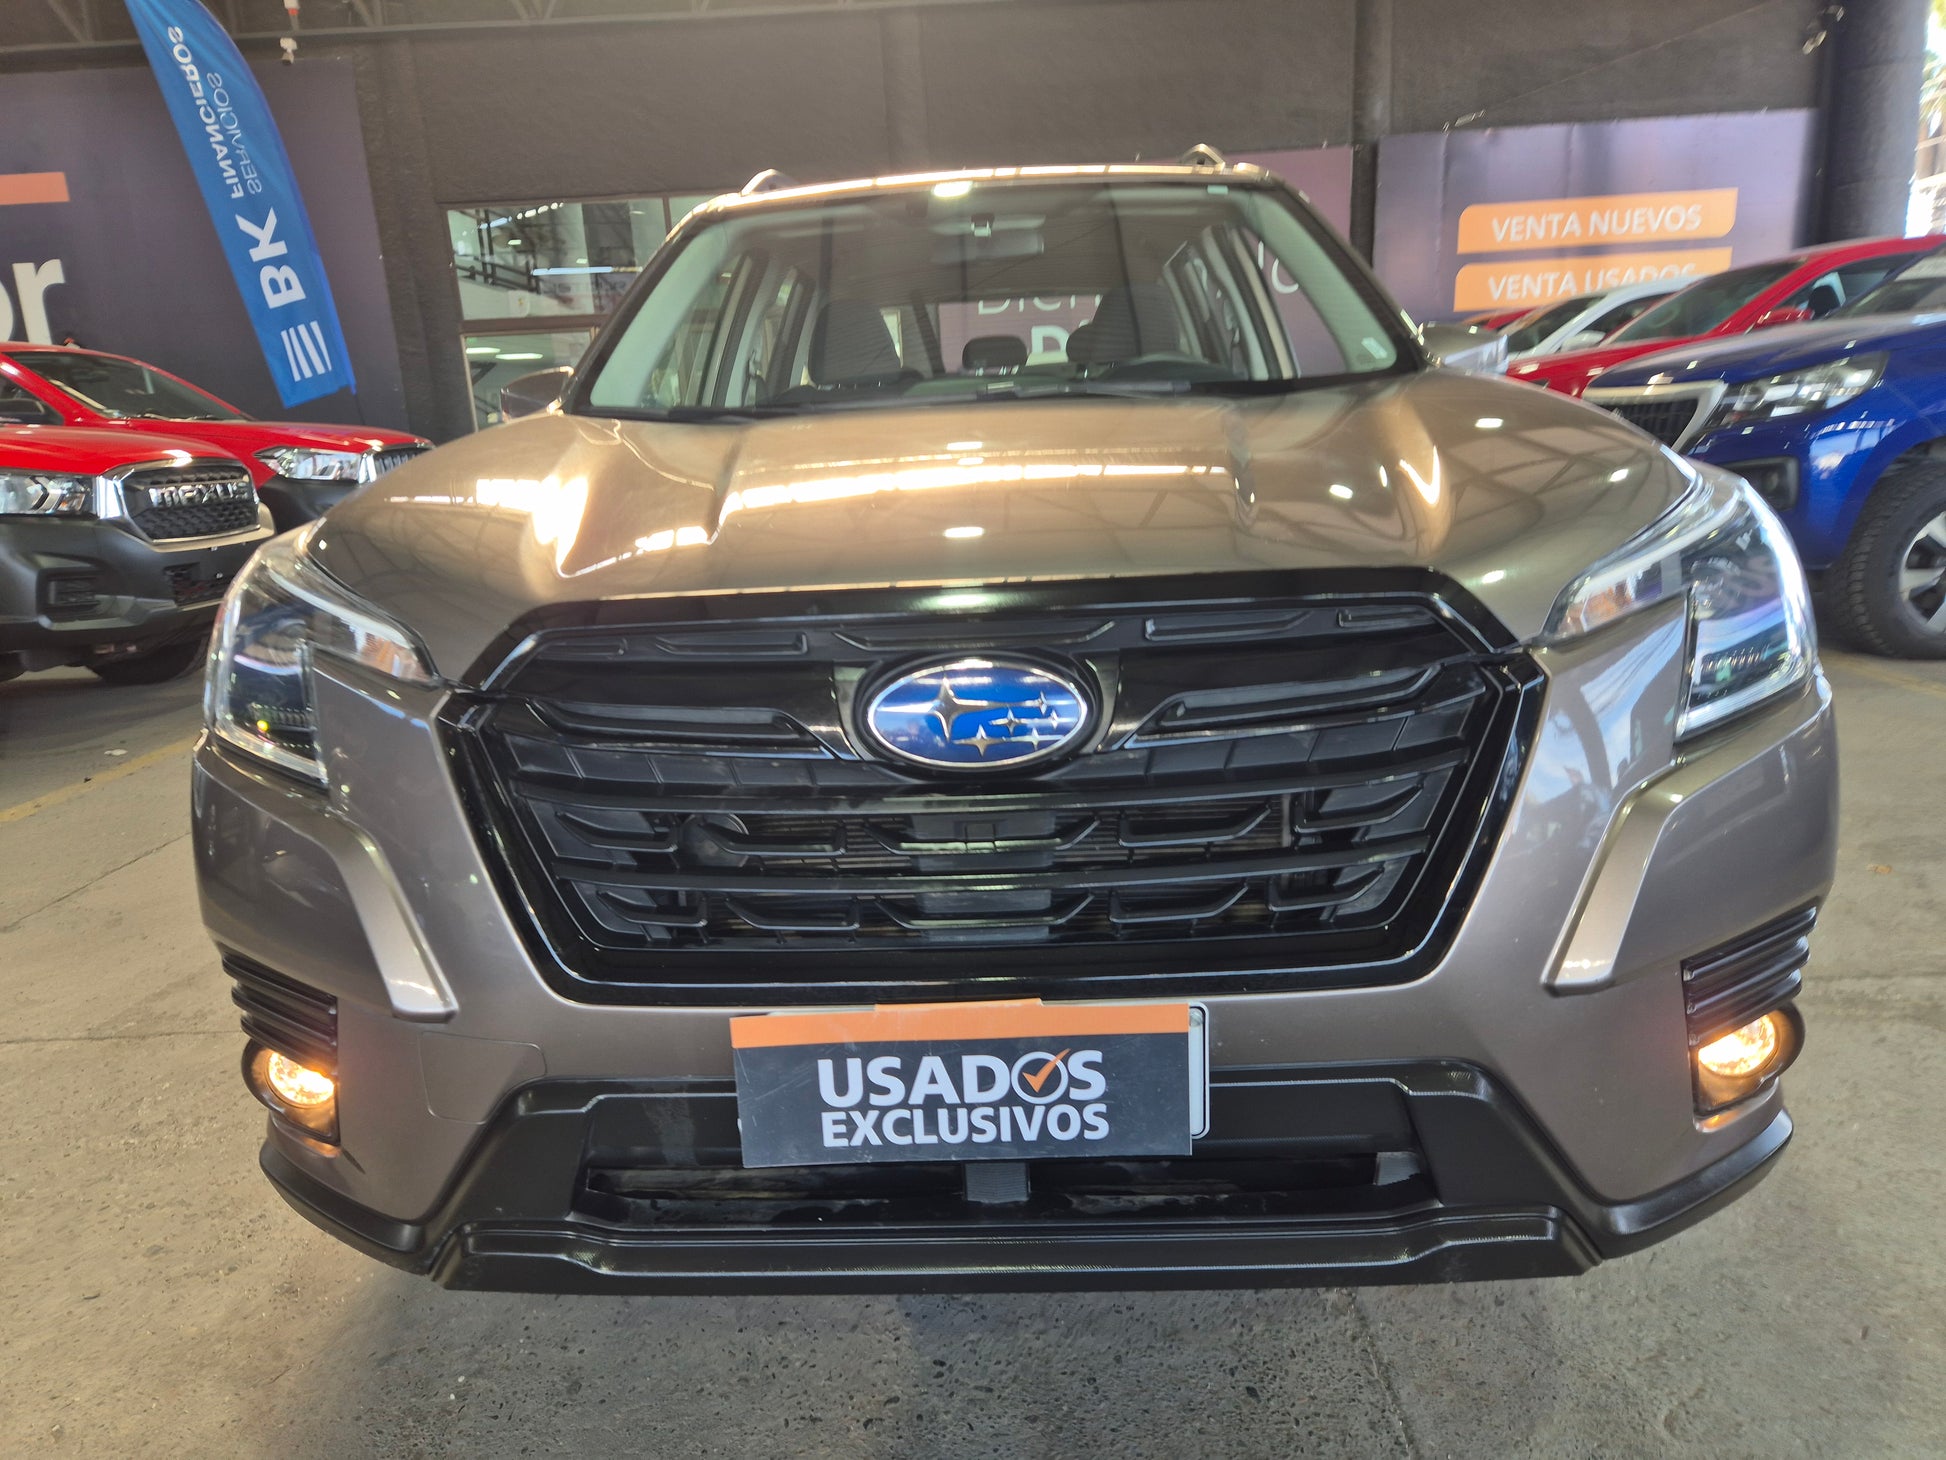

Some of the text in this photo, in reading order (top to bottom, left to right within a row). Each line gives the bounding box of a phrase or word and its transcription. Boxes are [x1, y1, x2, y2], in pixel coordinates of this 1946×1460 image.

[1491, 204, 1702, 243] VENTA NUEVOS
[0, 259, 65, 345] r
[1488, 271, 1577, 301] VENTA
[817, 1048, 1107, 1108] USADOS
[821, 1103, 1110, 1148] EXCLUSIVOS
